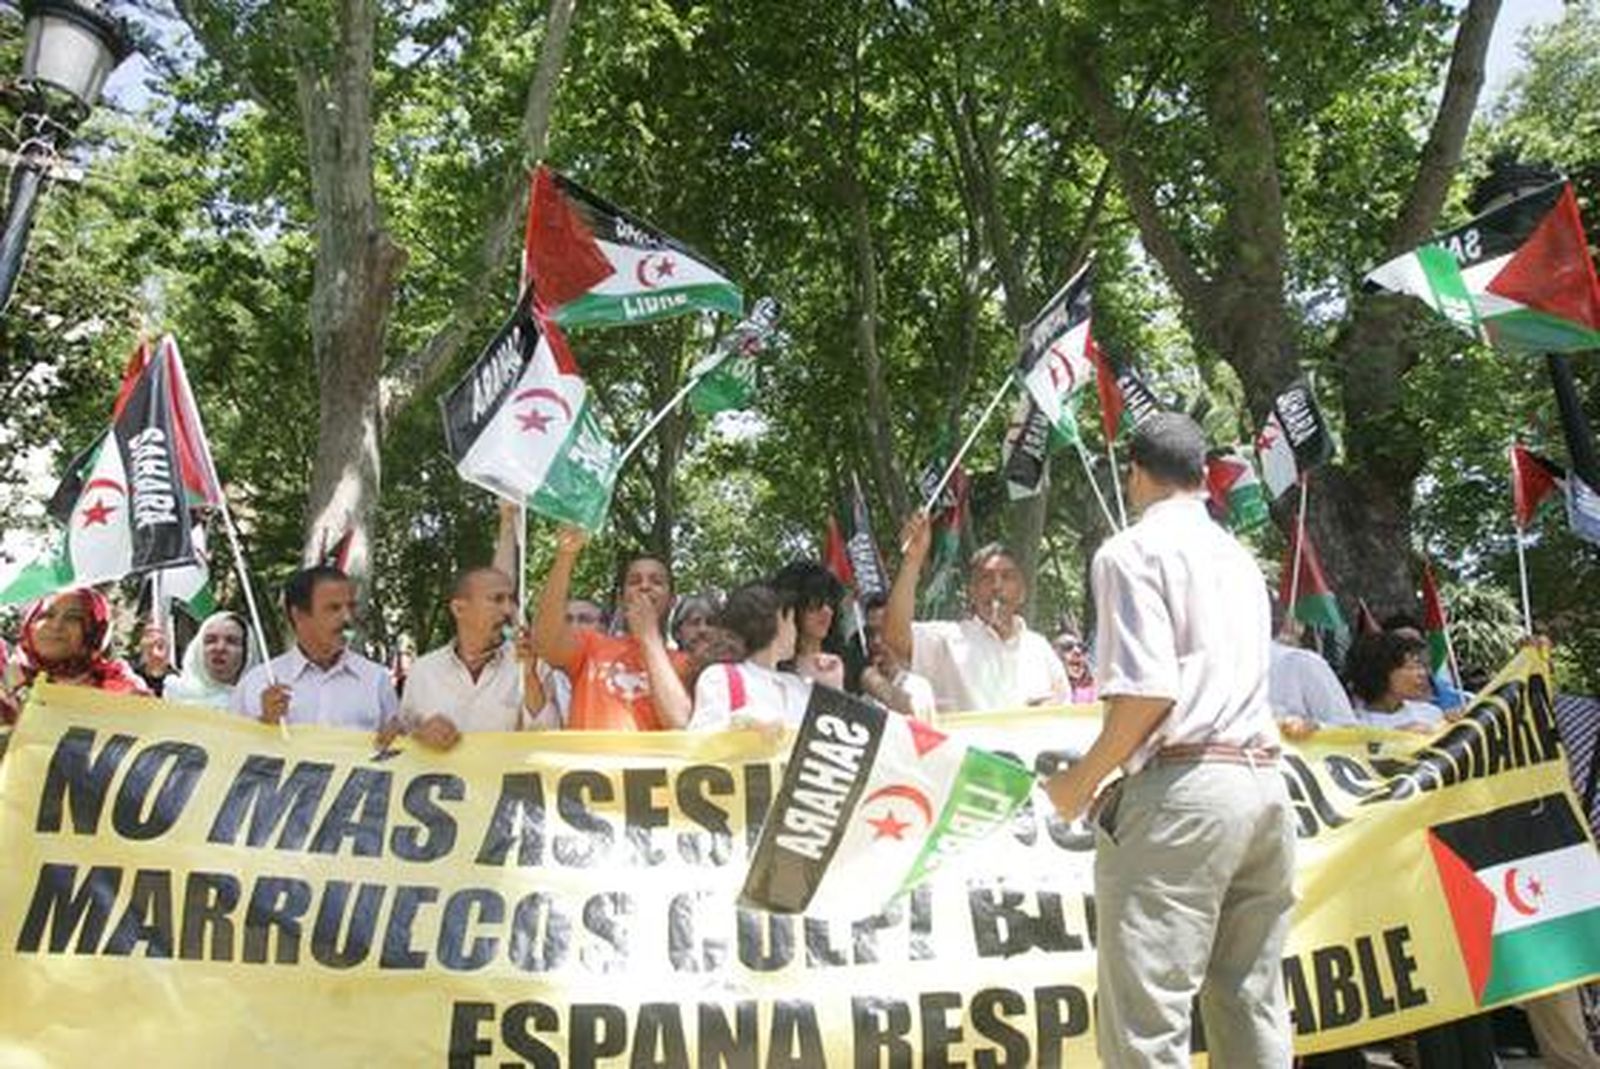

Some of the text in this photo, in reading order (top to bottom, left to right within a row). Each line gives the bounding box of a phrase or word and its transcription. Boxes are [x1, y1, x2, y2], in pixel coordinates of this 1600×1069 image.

[128, 427, 179, 529] SAHARA
[36, 727, 207, 840] NO
[16, 863, 633, 973] MARRUECOS
